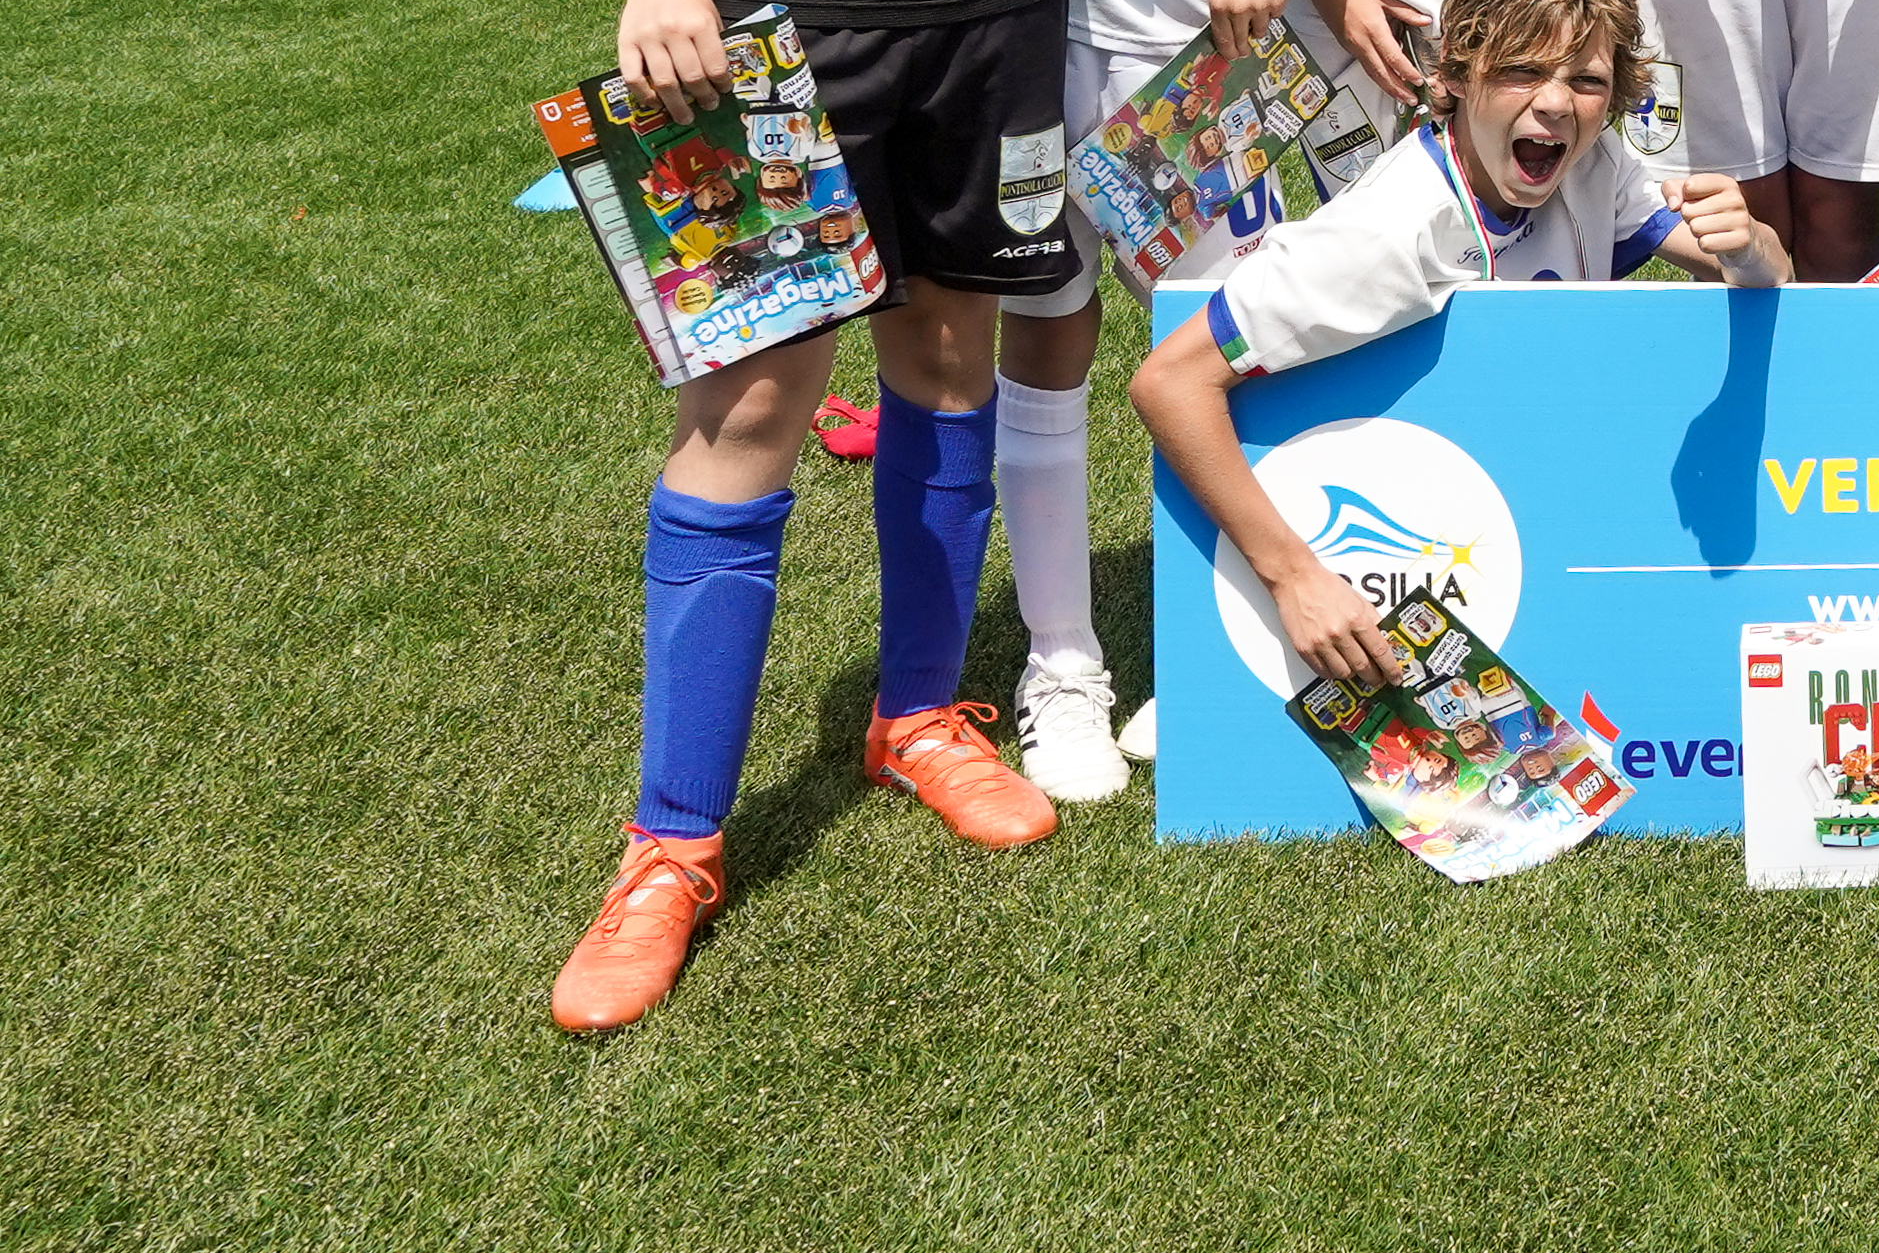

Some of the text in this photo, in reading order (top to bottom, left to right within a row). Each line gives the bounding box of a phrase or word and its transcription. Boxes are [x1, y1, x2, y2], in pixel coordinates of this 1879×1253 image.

[763, 133, 784, 145] 10
[690, 156, 703, 170] 7
[1081, 150, 1153, 245] Magazine
[1146, 239, 1173, 269] LEGO
[696, 271, 848, 339] Magazine
[1338, 573, 1467, 607] SILIA
[1750, 662, 1781, 679] LEGO
[1440, 700, 1456, 715] 10
[1398, 735, 1409, 748] 7
[1575, 771, 1602, 803] LEGO
